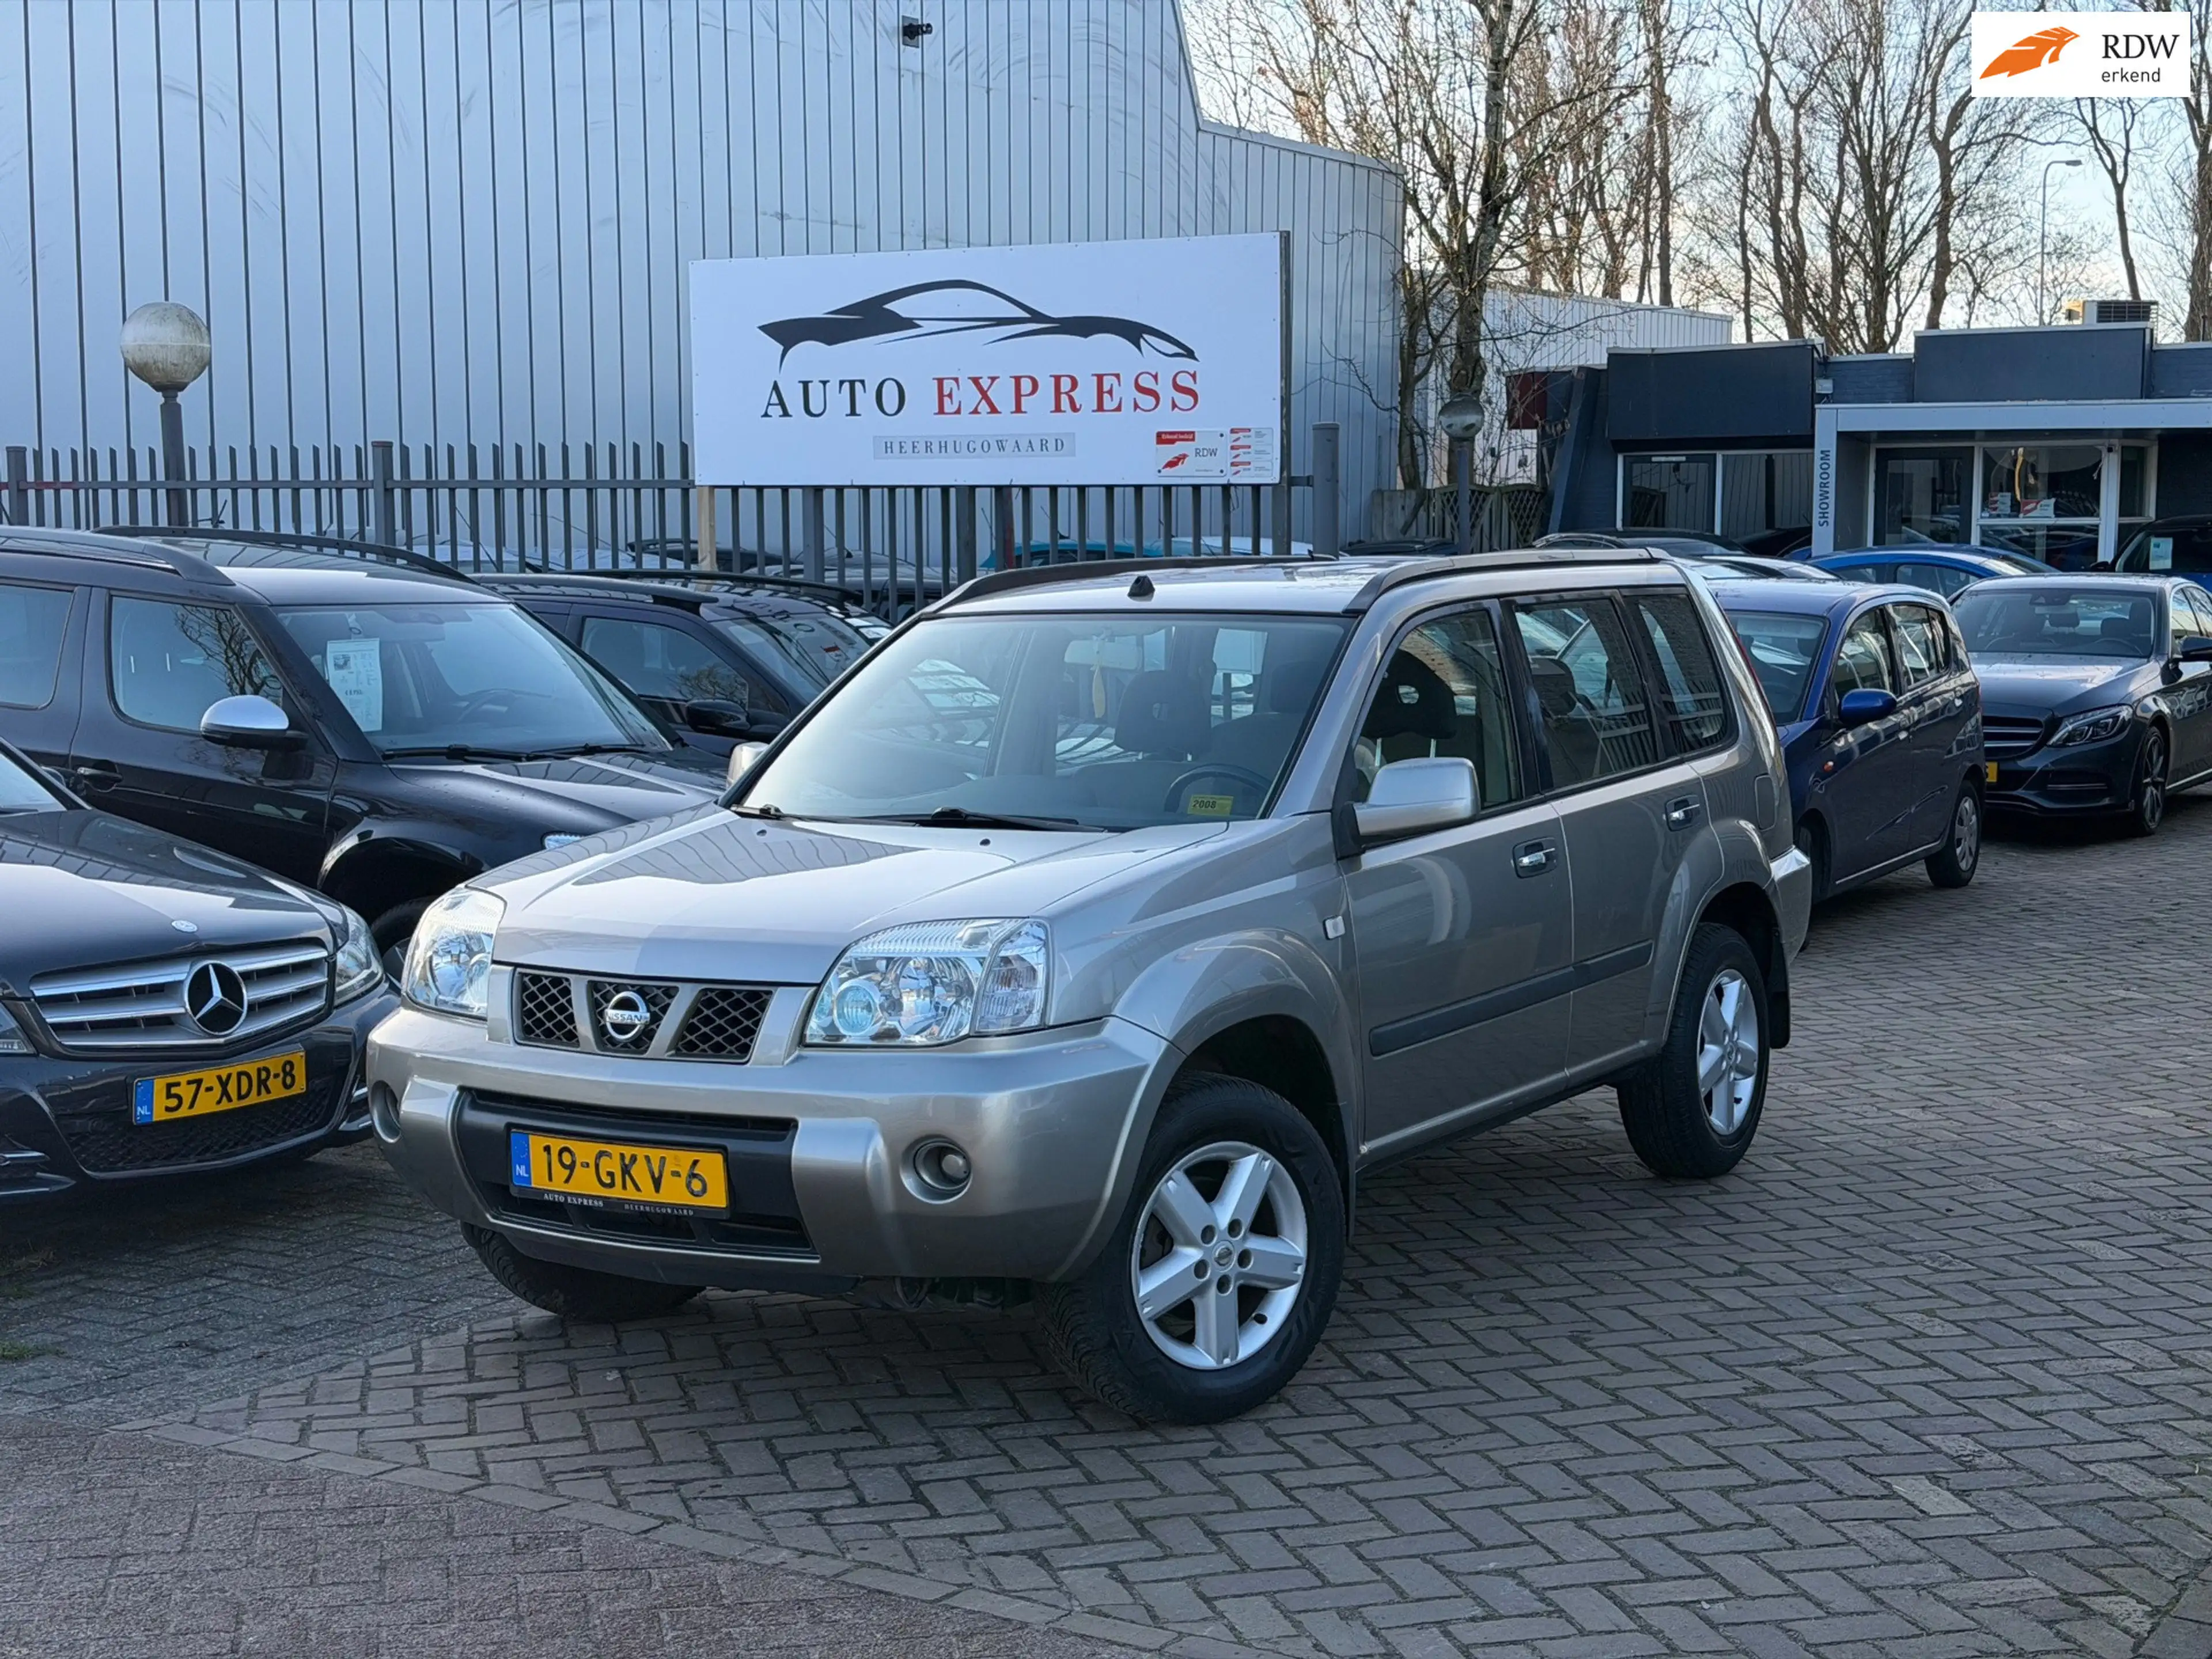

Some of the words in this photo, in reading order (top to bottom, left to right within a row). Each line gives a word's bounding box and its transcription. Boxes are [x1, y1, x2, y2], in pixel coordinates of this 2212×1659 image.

[761, 377, 906, 418] AUTO
[933, 370, 1200, 416] EXPRESS
[883, 437, 1065, 455] HEERHUGOWAARD
[1194, 448, 1218, 457] RDW
[1818, 450, 1831, 527] SHOWROOM
[1192, 800, 1217, 809] 2008
[606, 1012, 642, 1021] NISSAN
[164, 1060, 296, 1113] 57-XDR-8
[137, 1105, 150, 1115] NL
[516, 1164, 529, 1177] NL
[543, 1144, 708, 1198] 19-GKV-6
[543, 1193, 565, 1202] AUTO
[567, 1196, 604, 1207] EXPRESS
